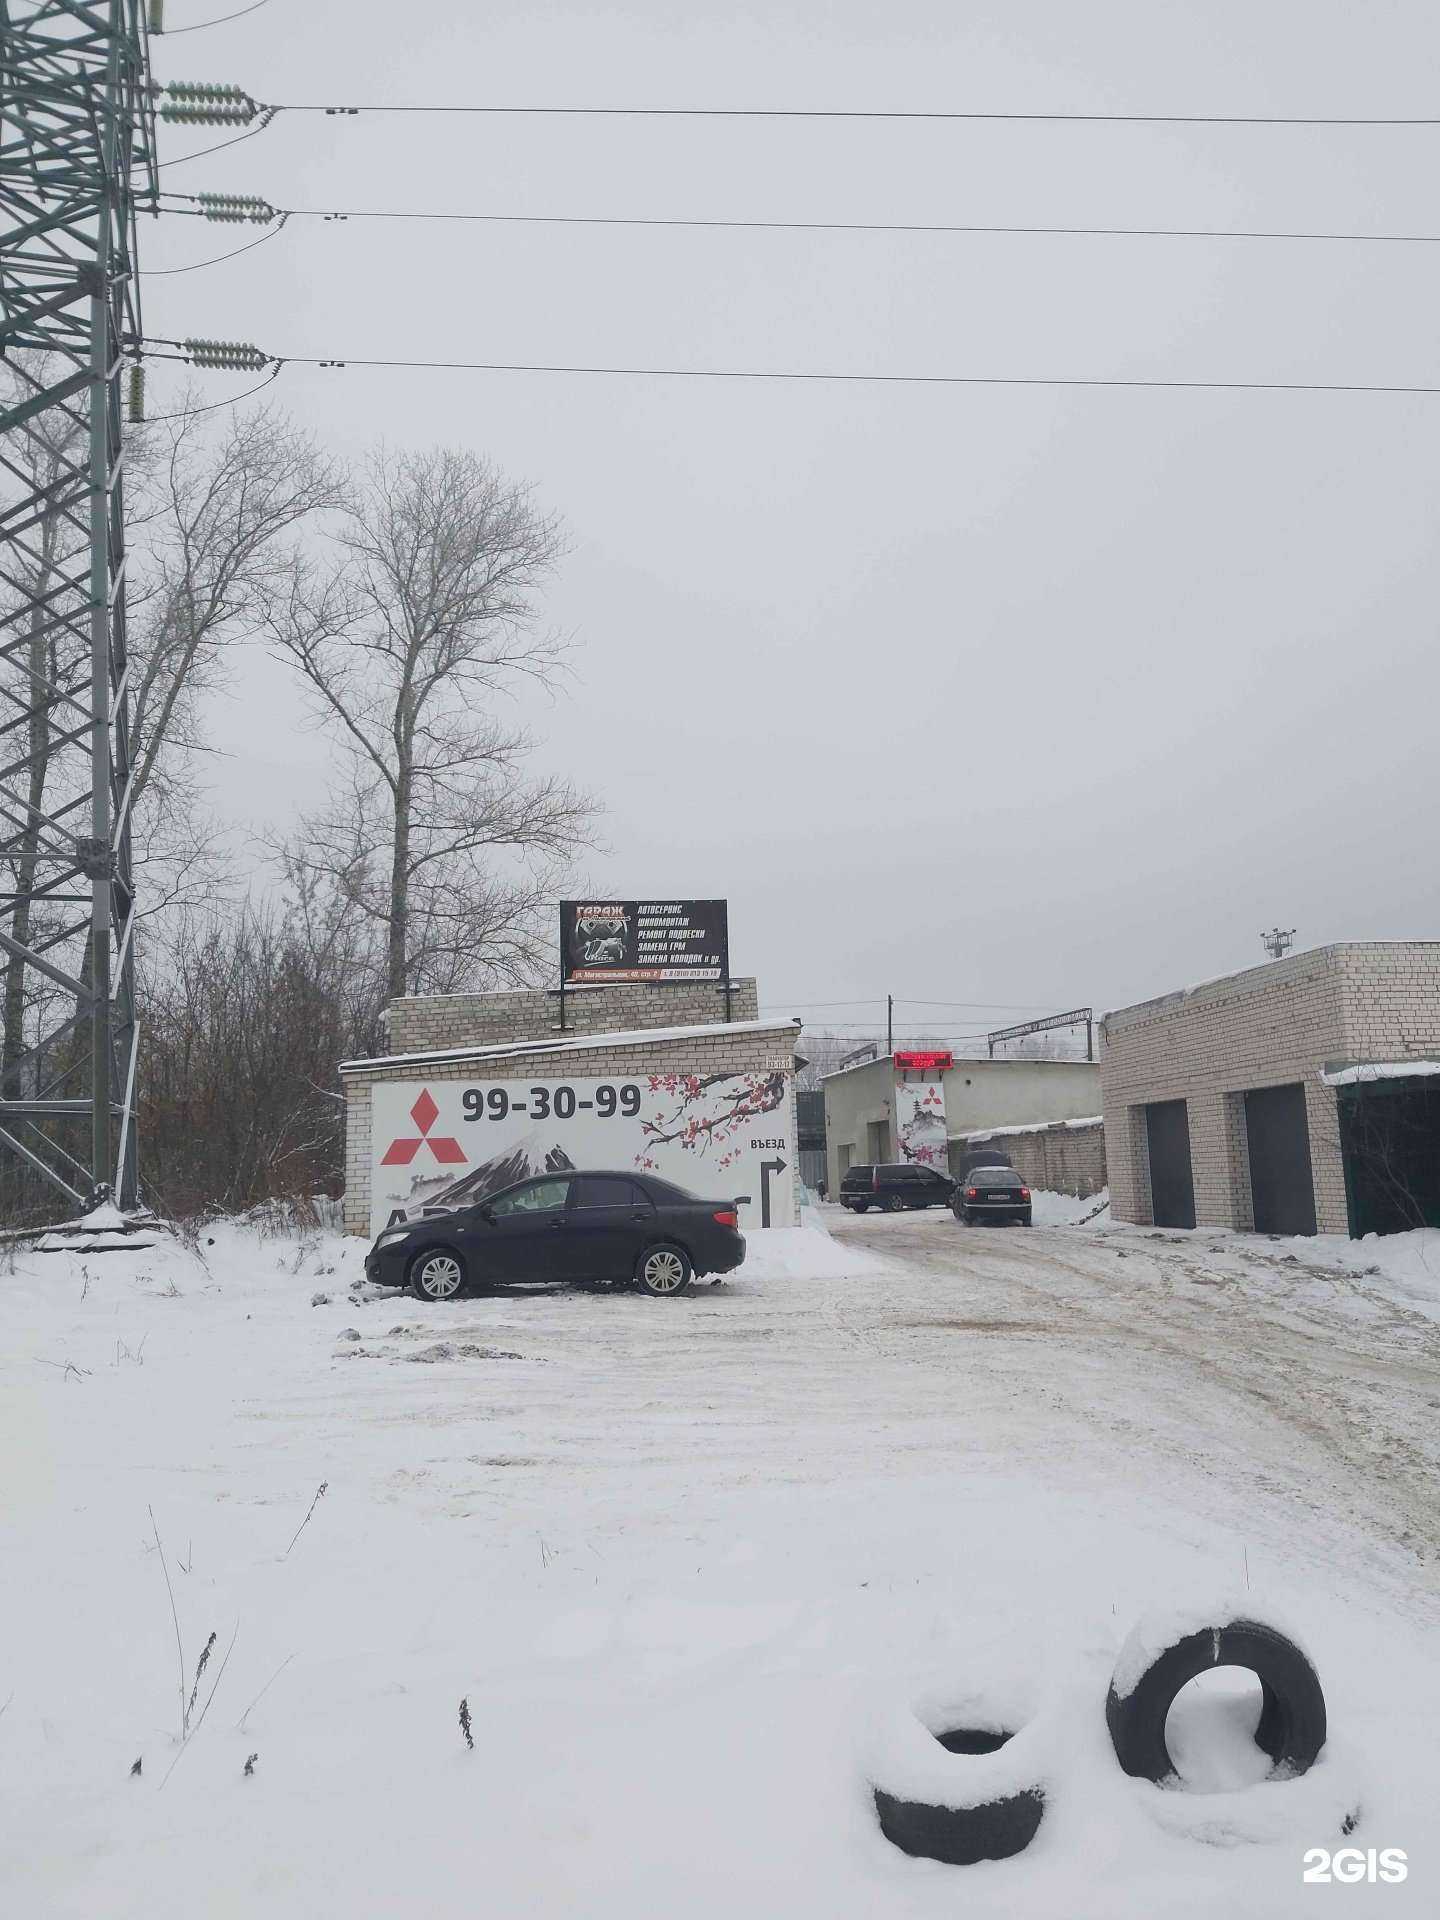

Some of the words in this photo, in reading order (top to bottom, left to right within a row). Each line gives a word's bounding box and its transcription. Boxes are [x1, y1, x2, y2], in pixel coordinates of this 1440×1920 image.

[637, 904, 683, 915] АВТОСЕРВИС
[637, 917, 690, 927] ШИНОМОНТАЖ
[637, 930, 667, 939] РЕМОНТ
[668, 929, 706, 940] ПОДВЕСКИ
[637, 942, 668, 952] ЗАМЕНА
[669, 941, 687, 951] ГРМ
[637, 954, 668, 964] ЗАМЕНА
[669, 954, 703, 964] КОЛОДОК
[710, 955, 721, 965] др.
[462, 1084, 641, 1121] 99-30-99
[750, 1138, 786, 1150] ВЪЕЗД
